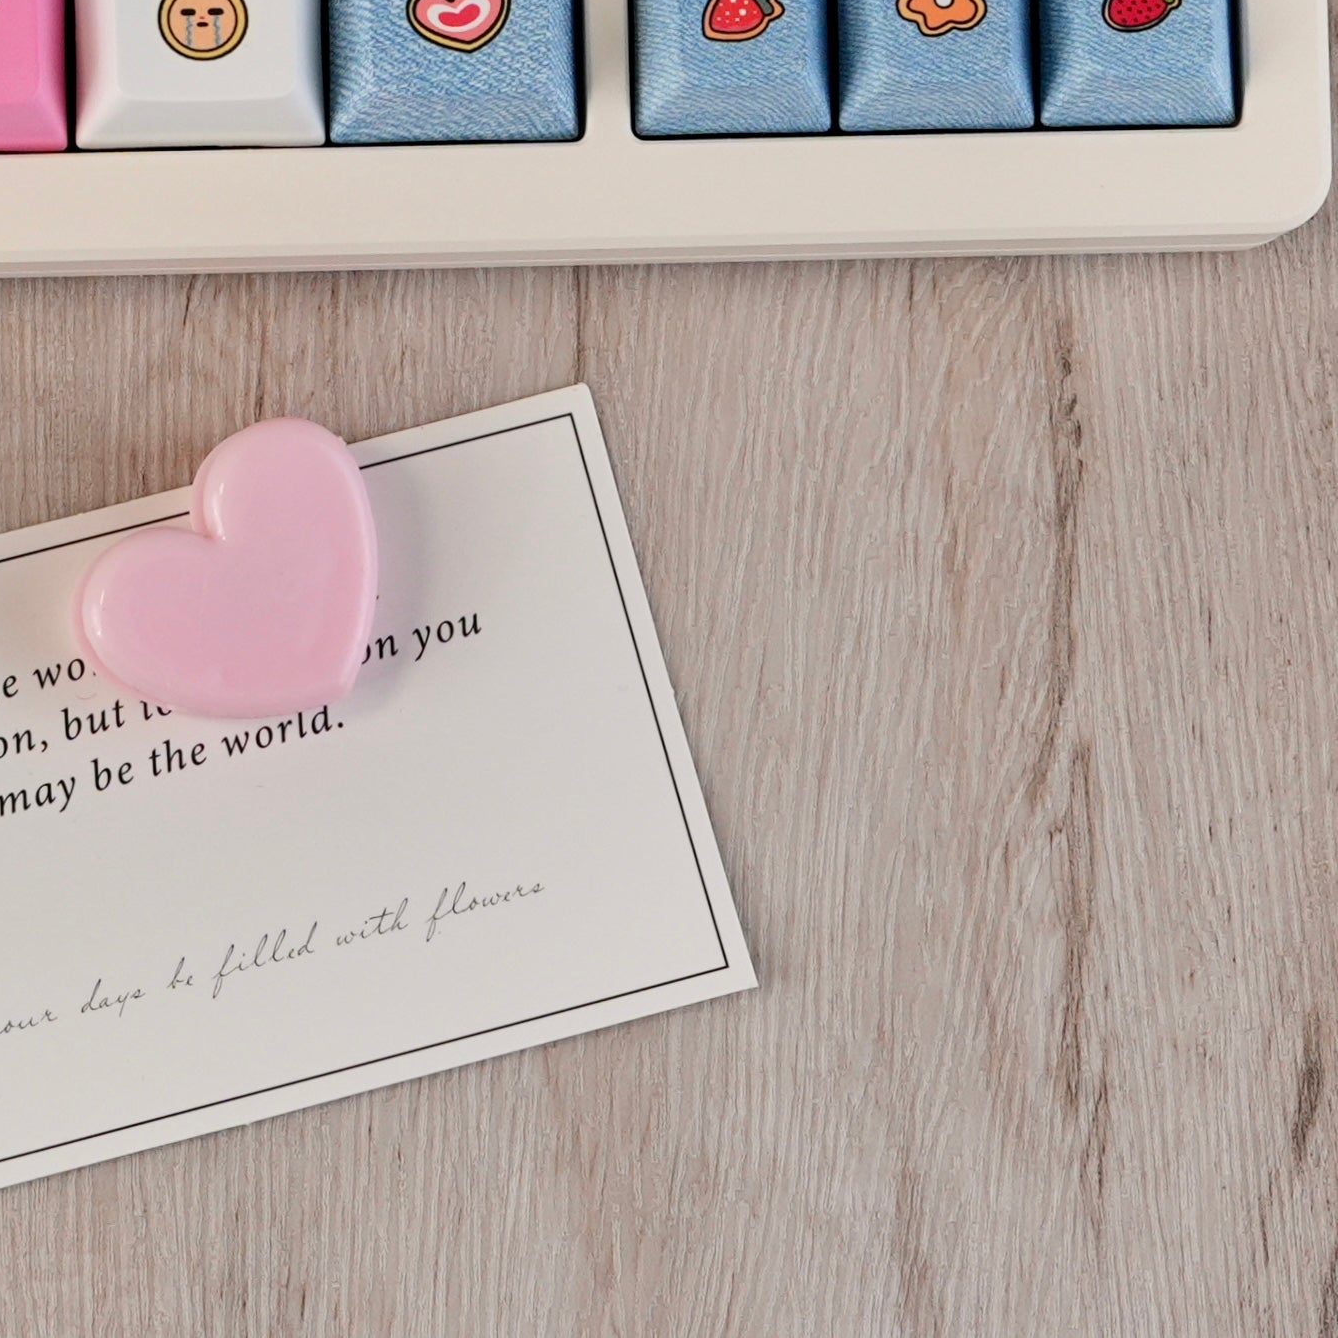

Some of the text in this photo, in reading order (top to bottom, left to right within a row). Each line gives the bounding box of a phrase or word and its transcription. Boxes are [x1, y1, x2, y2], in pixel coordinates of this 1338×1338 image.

[412, 613, 483, 662] you
[61, 699, 125, 741] but
[91, 758, 135, 792] be
[148, 739, 208, 777] the
[221, 705, 345, 757] world.
[80, 978, 146, 1017] days
[167, 956, 194, 989] be
[212, 921, 319, 1000] filled
[335, 897, 409, 947] with
[425, 881, 546, 943] flowers
